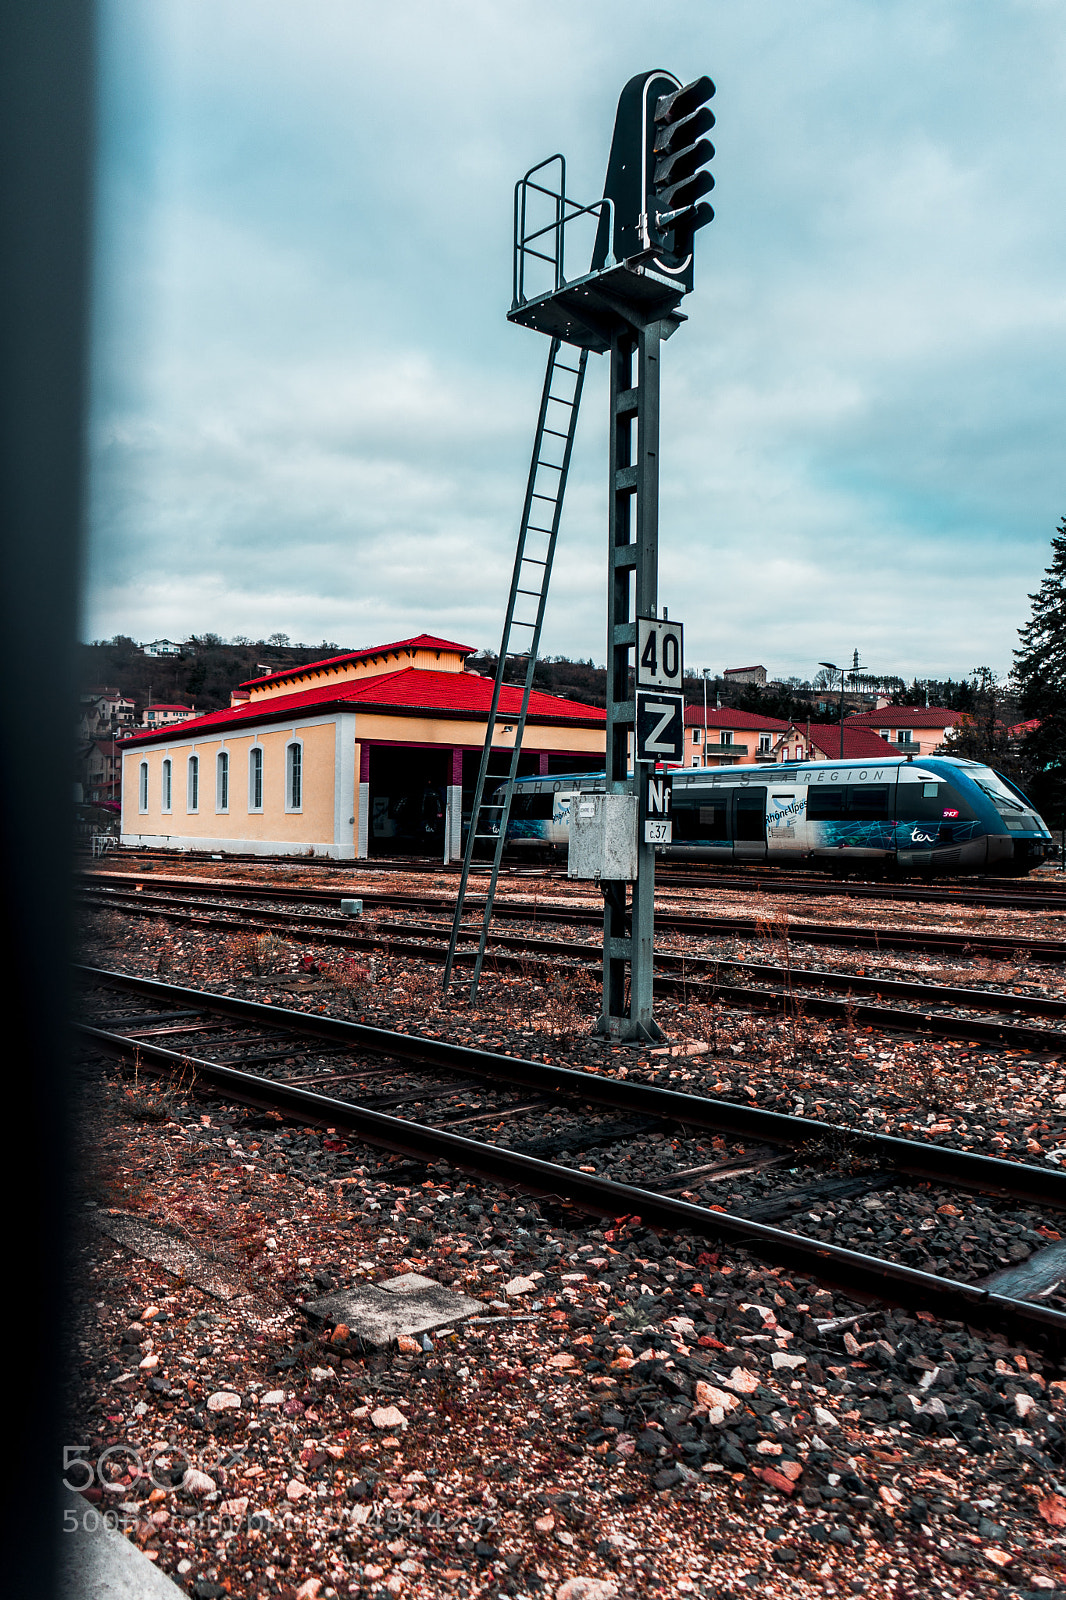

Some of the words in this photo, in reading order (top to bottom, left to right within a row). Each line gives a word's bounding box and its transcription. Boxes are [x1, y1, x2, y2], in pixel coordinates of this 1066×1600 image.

[641, 630, 679, 679] 40
[644, 701, 676, 754] Z
[803, 770, 884, 782] RÉGION
[648, 779, 671, 813] Nf
[910, 827, 935, 842] ter
